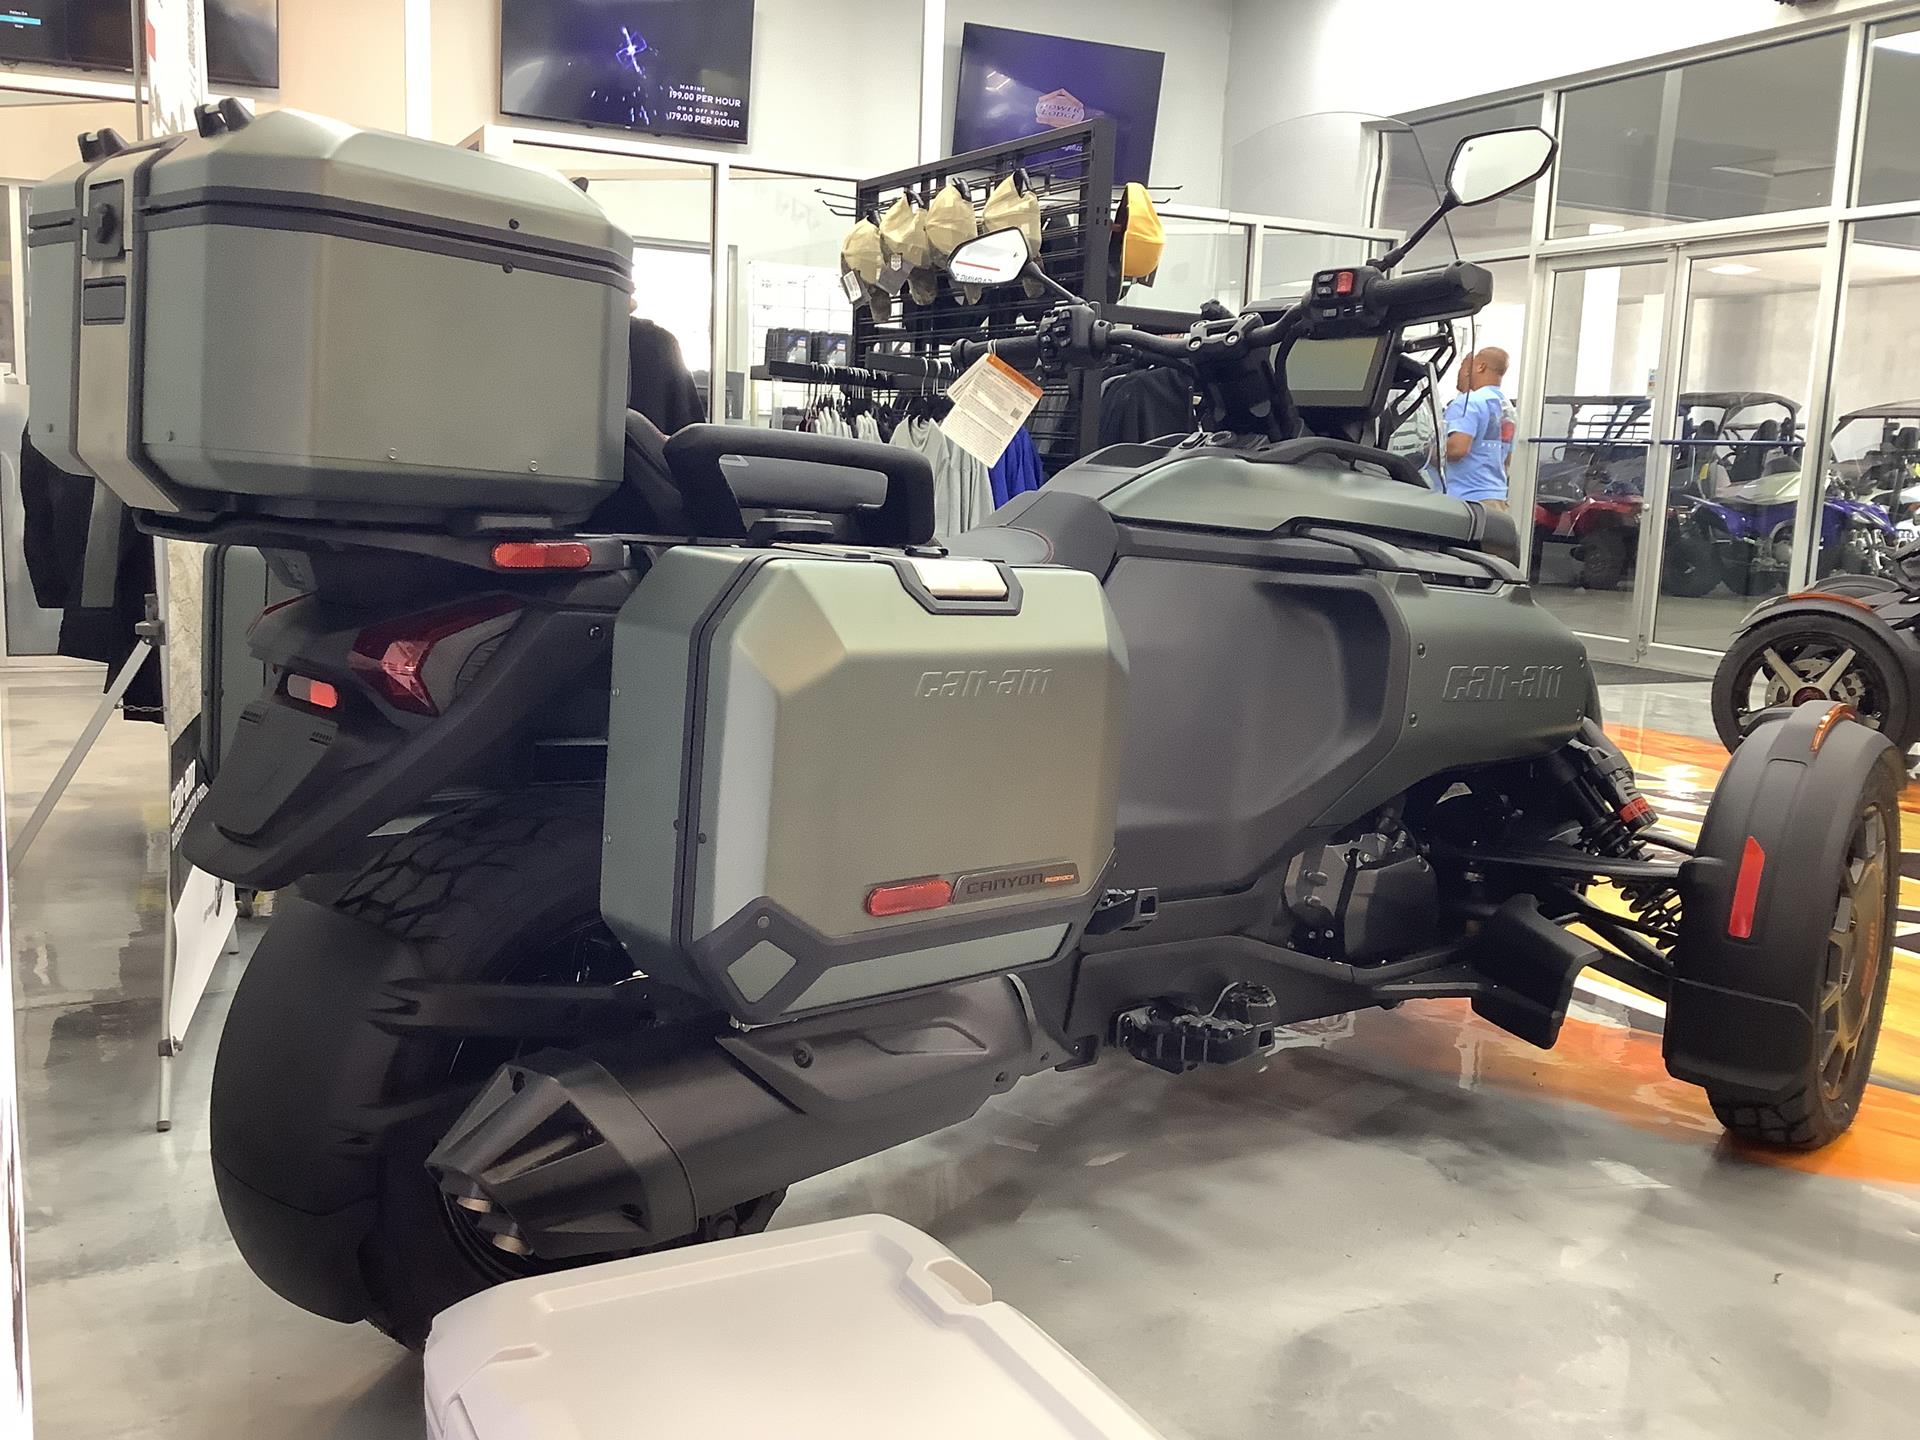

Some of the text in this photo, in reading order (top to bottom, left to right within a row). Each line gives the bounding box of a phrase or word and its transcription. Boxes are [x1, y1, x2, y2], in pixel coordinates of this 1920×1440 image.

[679, 84, 706, 93] MARINE
[695, 94, 714, 104] PER
[715, 97, 742, 107] HOUR
[694, 115, 713, 125] PER
[714, 118, 740, 128] HOUR
[967, 873, 1043, 894] CANYON
